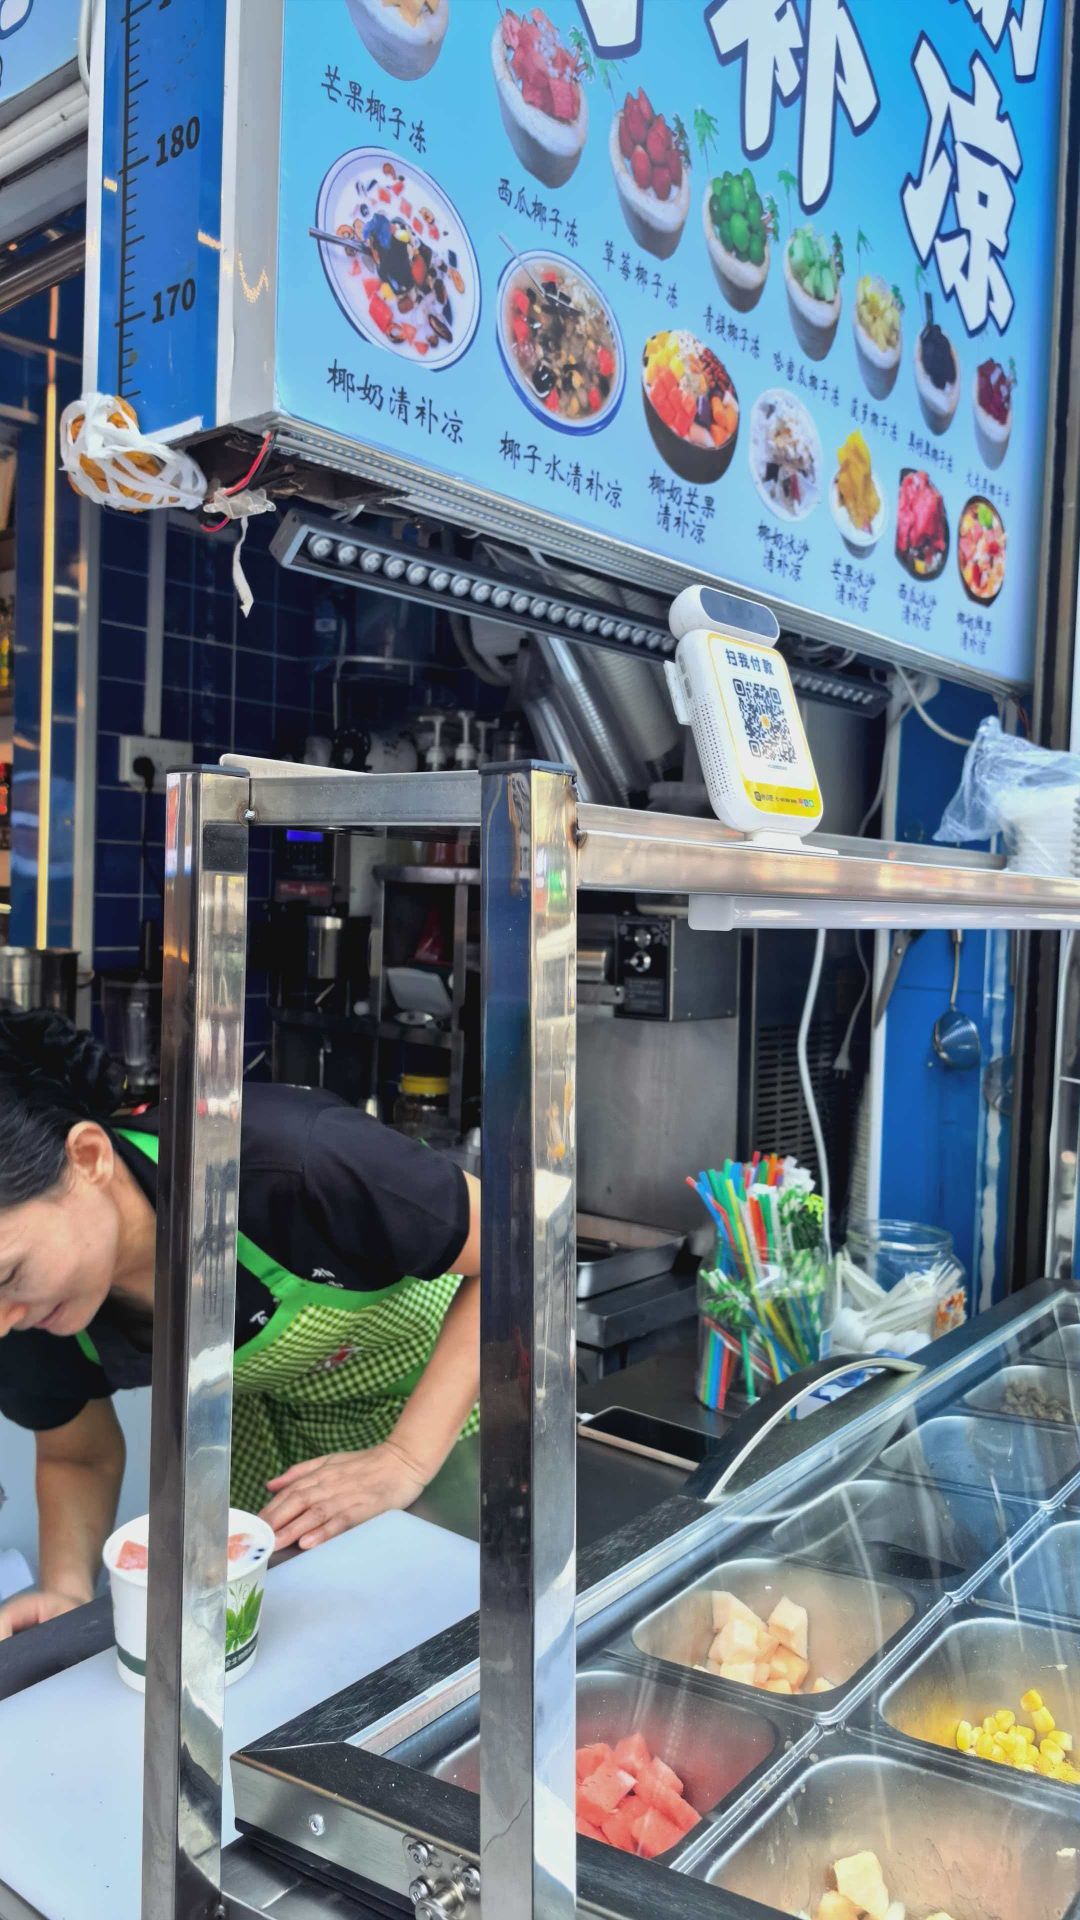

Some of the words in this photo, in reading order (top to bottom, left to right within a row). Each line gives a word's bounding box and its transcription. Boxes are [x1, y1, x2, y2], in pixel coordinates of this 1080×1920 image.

[321, 64, 428, 154] 芒果椰子冻
[156, 116, 201, 167] 180
[498, 178, 579, 248] 西瓜椰子冻
[151, 278, 196, 324] 170
[602, 240, 679, 309] 草莓椰子冻
[703, 304, 760, 360] 青提椰子冻
[326, 359, 464, 445] 椰奶清补凉
[499, 432, 623, 509] 椰子水清补凉
[648, 470, 716, 519] 椰奶芒果
[656, 502, 706, 545] 清补凉
[725, 648, 775, 676] 扫我付款
